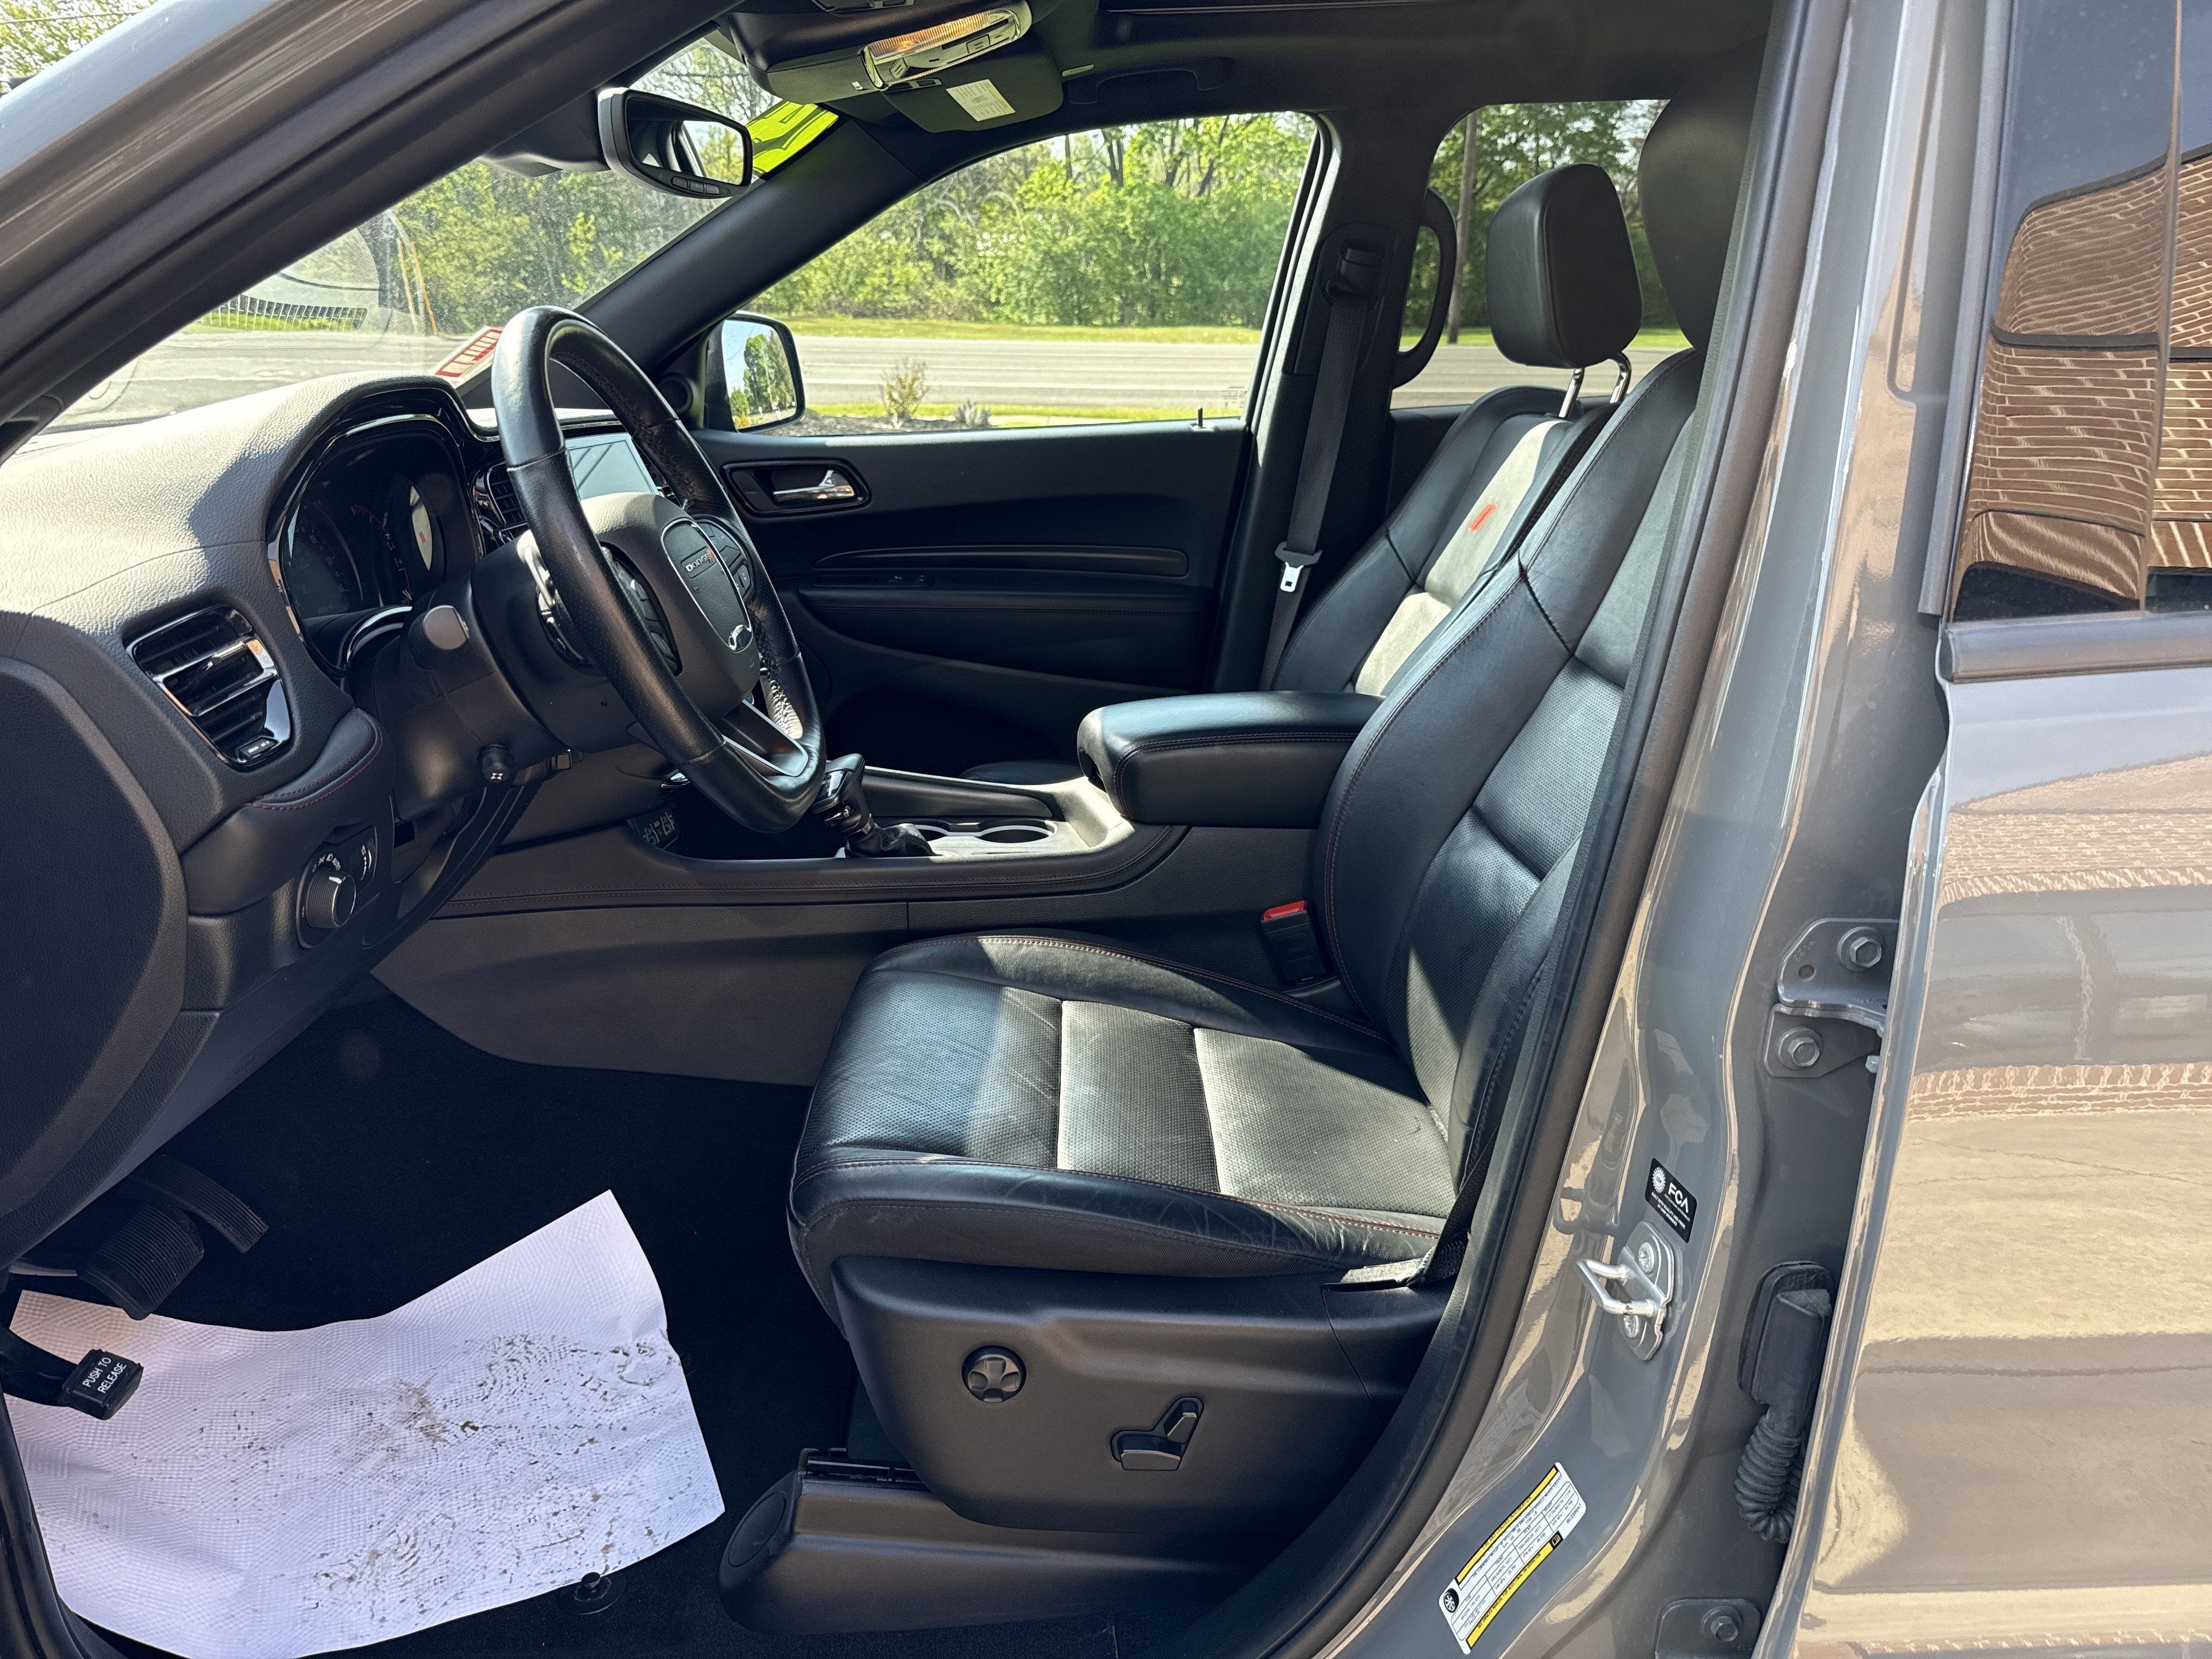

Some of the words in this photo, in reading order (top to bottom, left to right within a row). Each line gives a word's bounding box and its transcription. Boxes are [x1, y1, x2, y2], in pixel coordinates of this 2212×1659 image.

[685, 554, 710, 572] DODGE
[332, 857, 341, 871] AUTO
[1668, 1182, 1688, 1213] FCA
[82, 1367, 103, 1387] PUSH
[98, 1357, 111, 1367] TO
[97, 1362, 127, 1393] RELEASE
